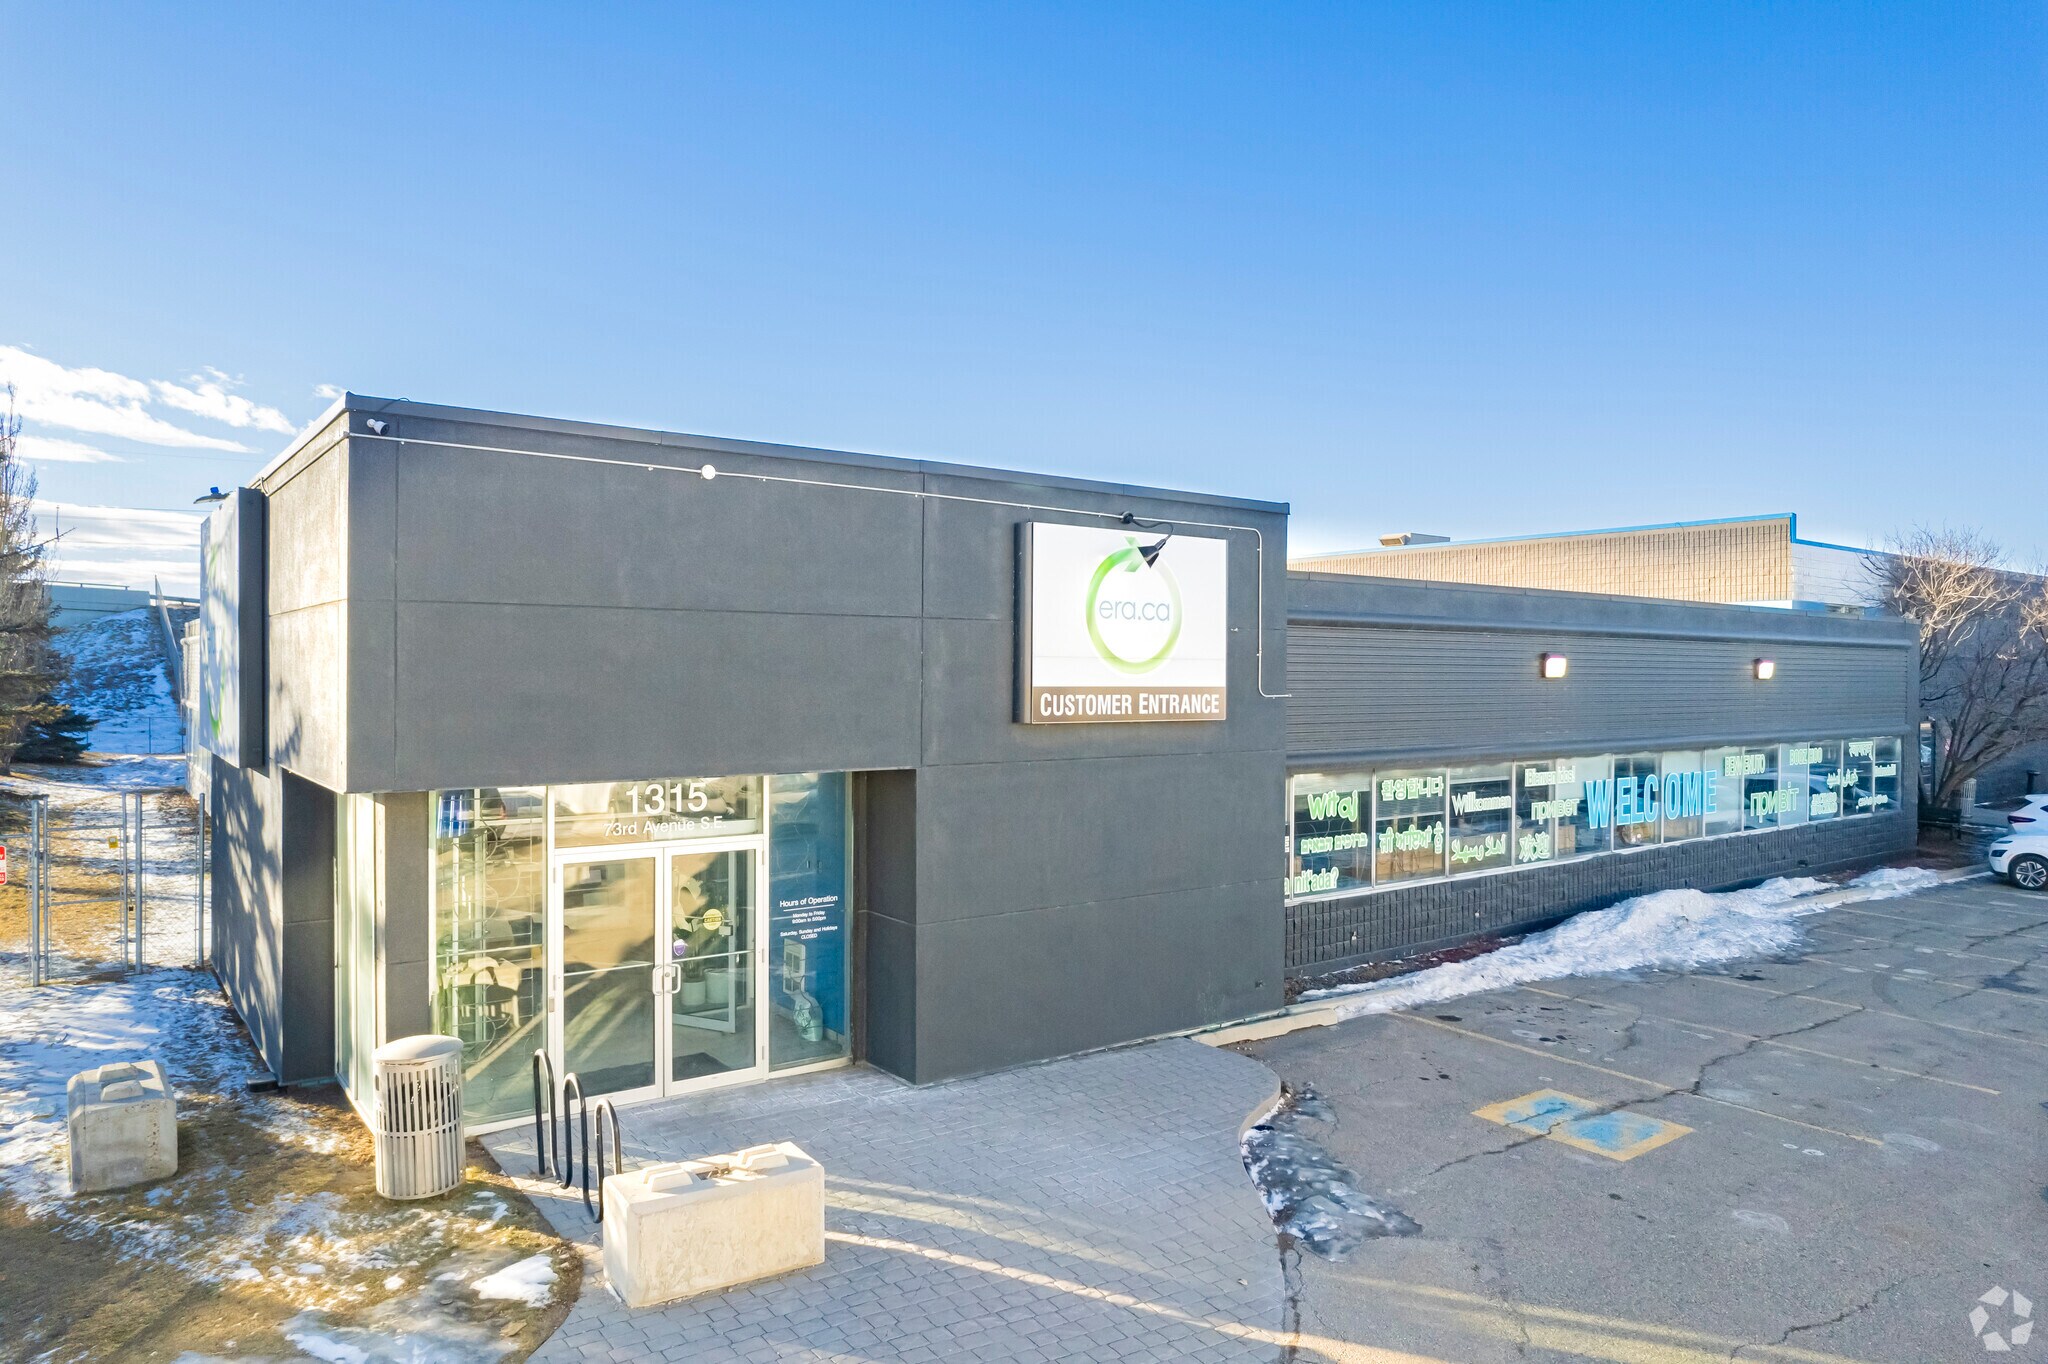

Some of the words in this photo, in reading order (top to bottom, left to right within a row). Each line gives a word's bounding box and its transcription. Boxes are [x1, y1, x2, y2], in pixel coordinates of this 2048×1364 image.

[1099, 600, 1170, 622] era.ca
[1040, 693, 1132, 716] CUSTOMER
[1138, 693, 1220, 715] ENTRANCE
[626, 783, 708, 816] 1315
[1381, 776, 1444, 801] 환영합니다
[1586, 770, 1718, 829] WELCOME
[1307, 790, 1358, 822] Witaj
[1451, 791, 1512, 816] Willkommen
[603, 821, 637, 837] 73rd
[643, 820, 695, 834] Avenue
[1519, 831, 1550, 862] 欢迎
[808, 895, 838, 905] Operation
